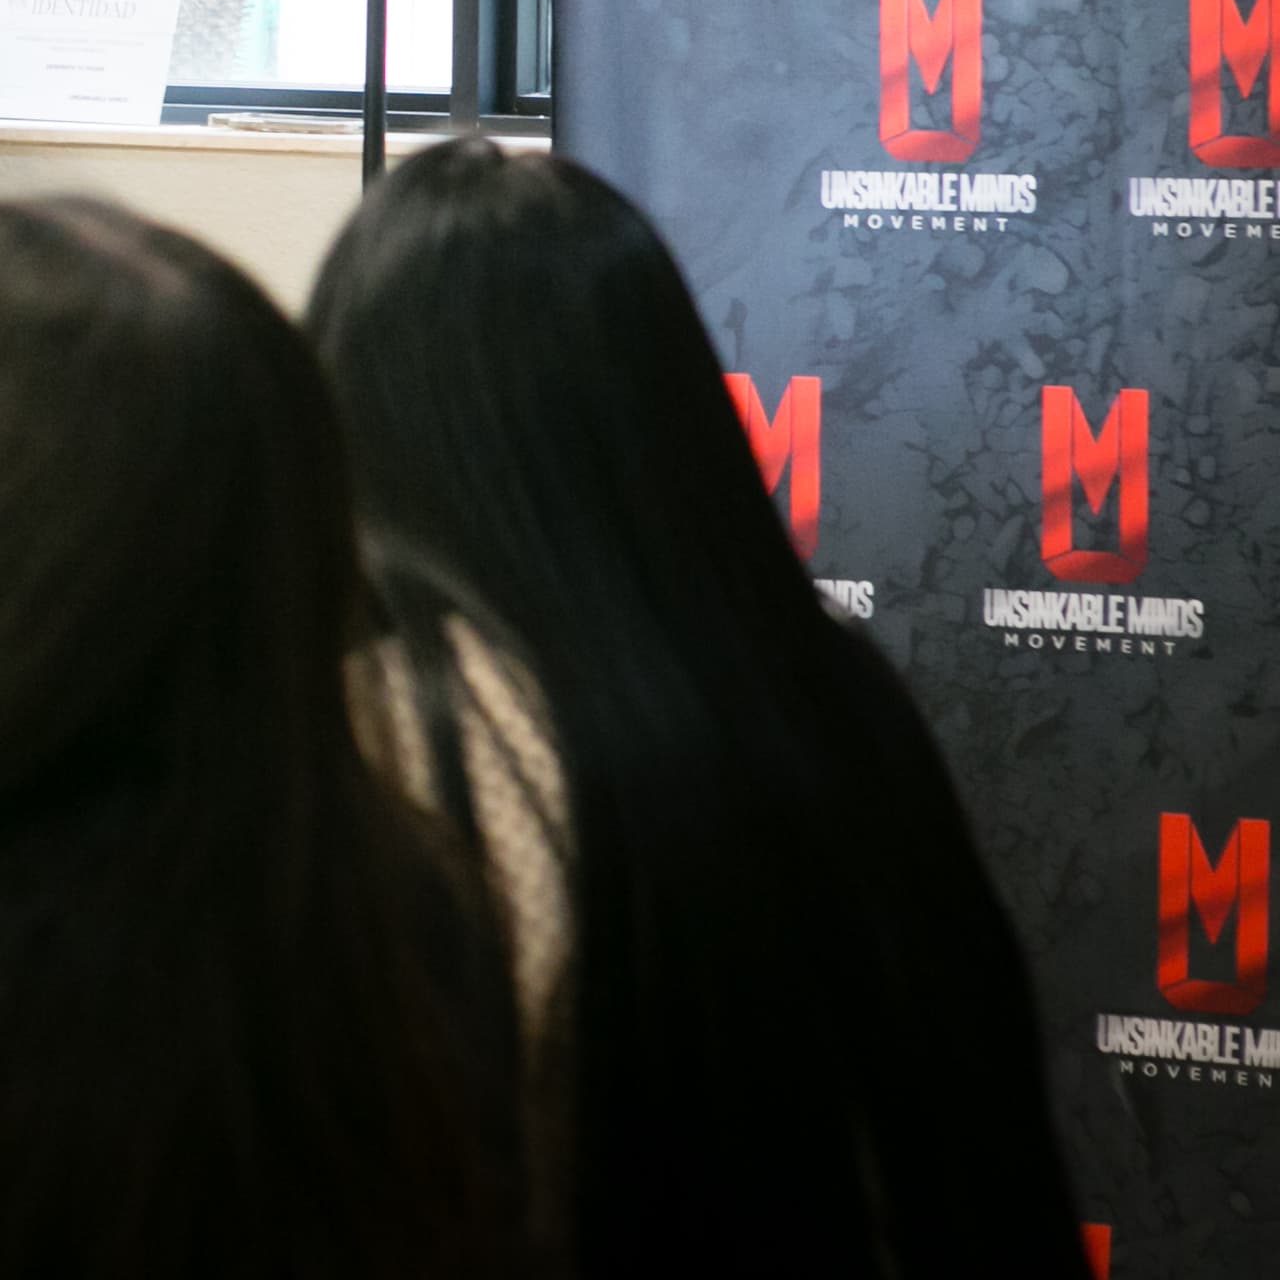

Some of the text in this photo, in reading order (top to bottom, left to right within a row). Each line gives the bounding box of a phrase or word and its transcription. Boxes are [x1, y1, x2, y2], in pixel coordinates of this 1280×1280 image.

[821, 170, 1037, 213] UNSINKABLE MINDS
[1129, 177, 1274, 218] UNSINKABLE
[844, 213, 1008, 232] MOVEMENT
[983, 588, 1204, 639] UNSINKABLE MINDS
[1004, 632, 1176, 656] MOVEMENT
[1097, 1013, 1240, 1065] UNSINKABLE
[1120, 1060, 1273, 1088] MOVEMEN
